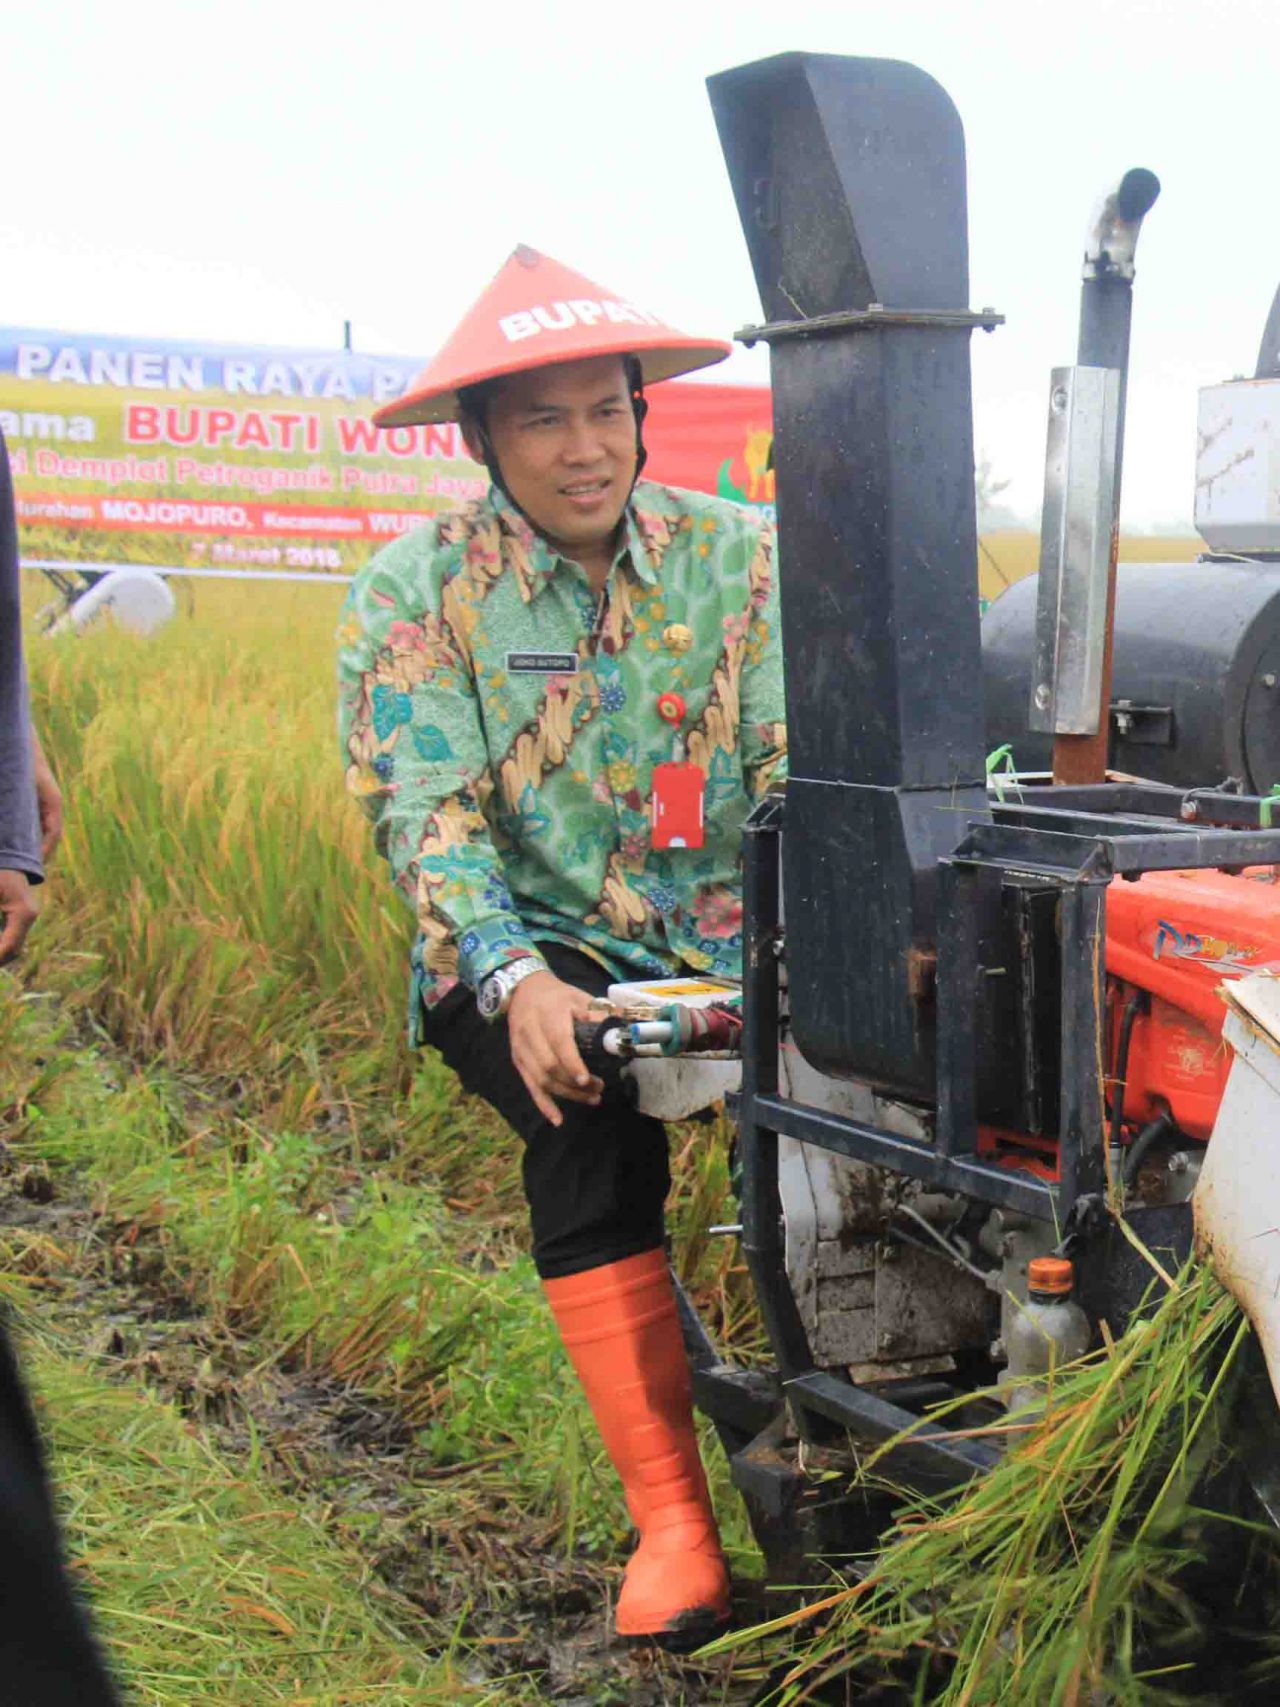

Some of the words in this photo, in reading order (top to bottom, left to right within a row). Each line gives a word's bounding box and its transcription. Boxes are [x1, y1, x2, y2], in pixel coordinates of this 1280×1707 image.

[17, 343, 204, 392] PANEN
[224, 358, 356, 402] RAYA
[126, 405, 319, 450] BUPATI
[37, 448, 166, 485] Demplot
[176, 456, 332, 494] Petroganik
[102, 500, 254, 529] MOJOPURO,
